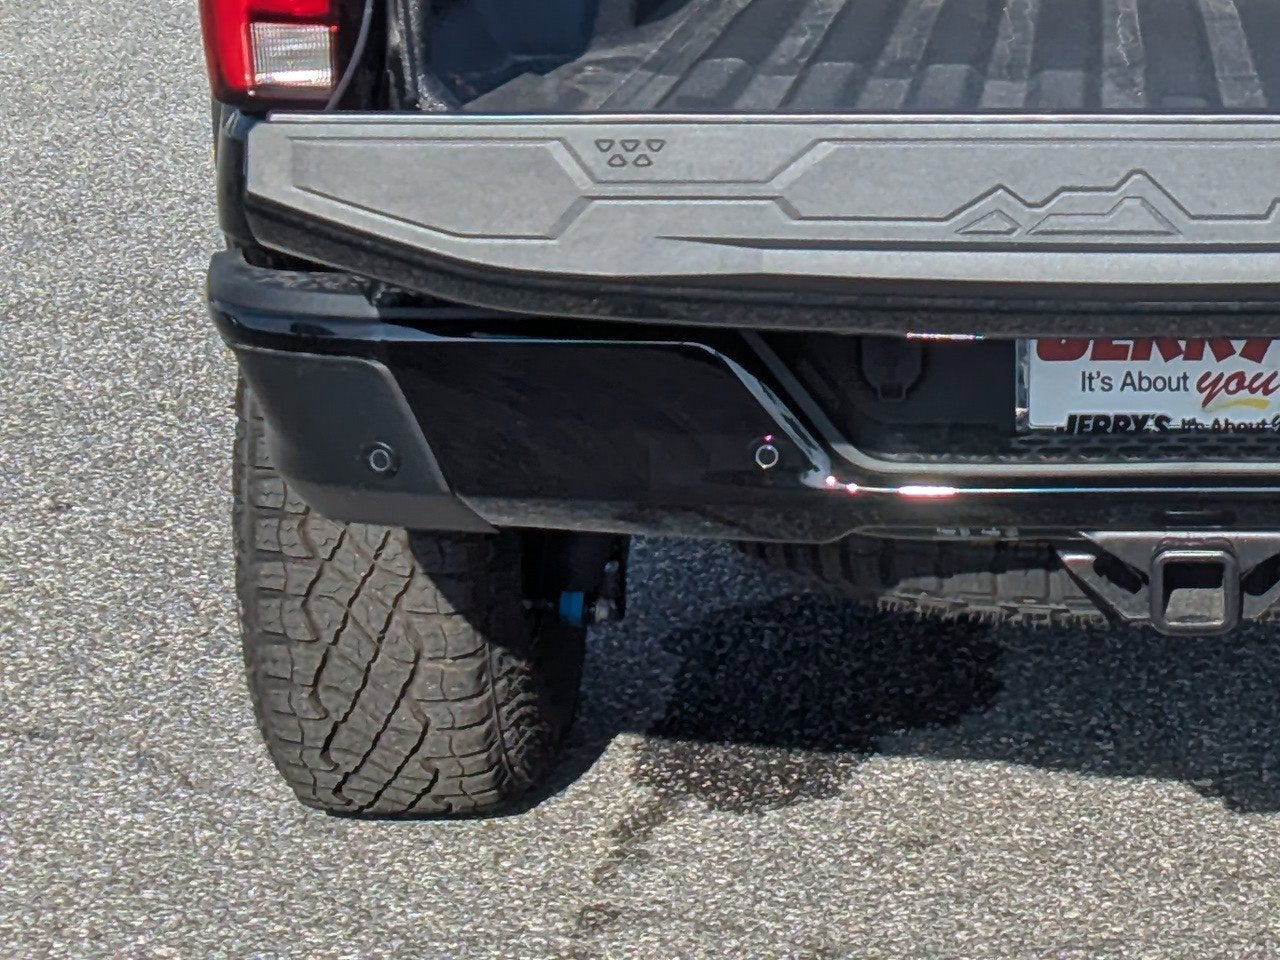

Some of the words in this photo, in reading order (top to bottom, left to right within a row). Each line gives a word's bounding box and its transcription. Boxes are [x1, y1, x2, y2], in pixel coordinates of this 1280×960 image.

[1081, 370, 1113, 392] It's
[1120, 370, 1189, 392] About
[1057, 413, 1172, 434] JERRY'S
